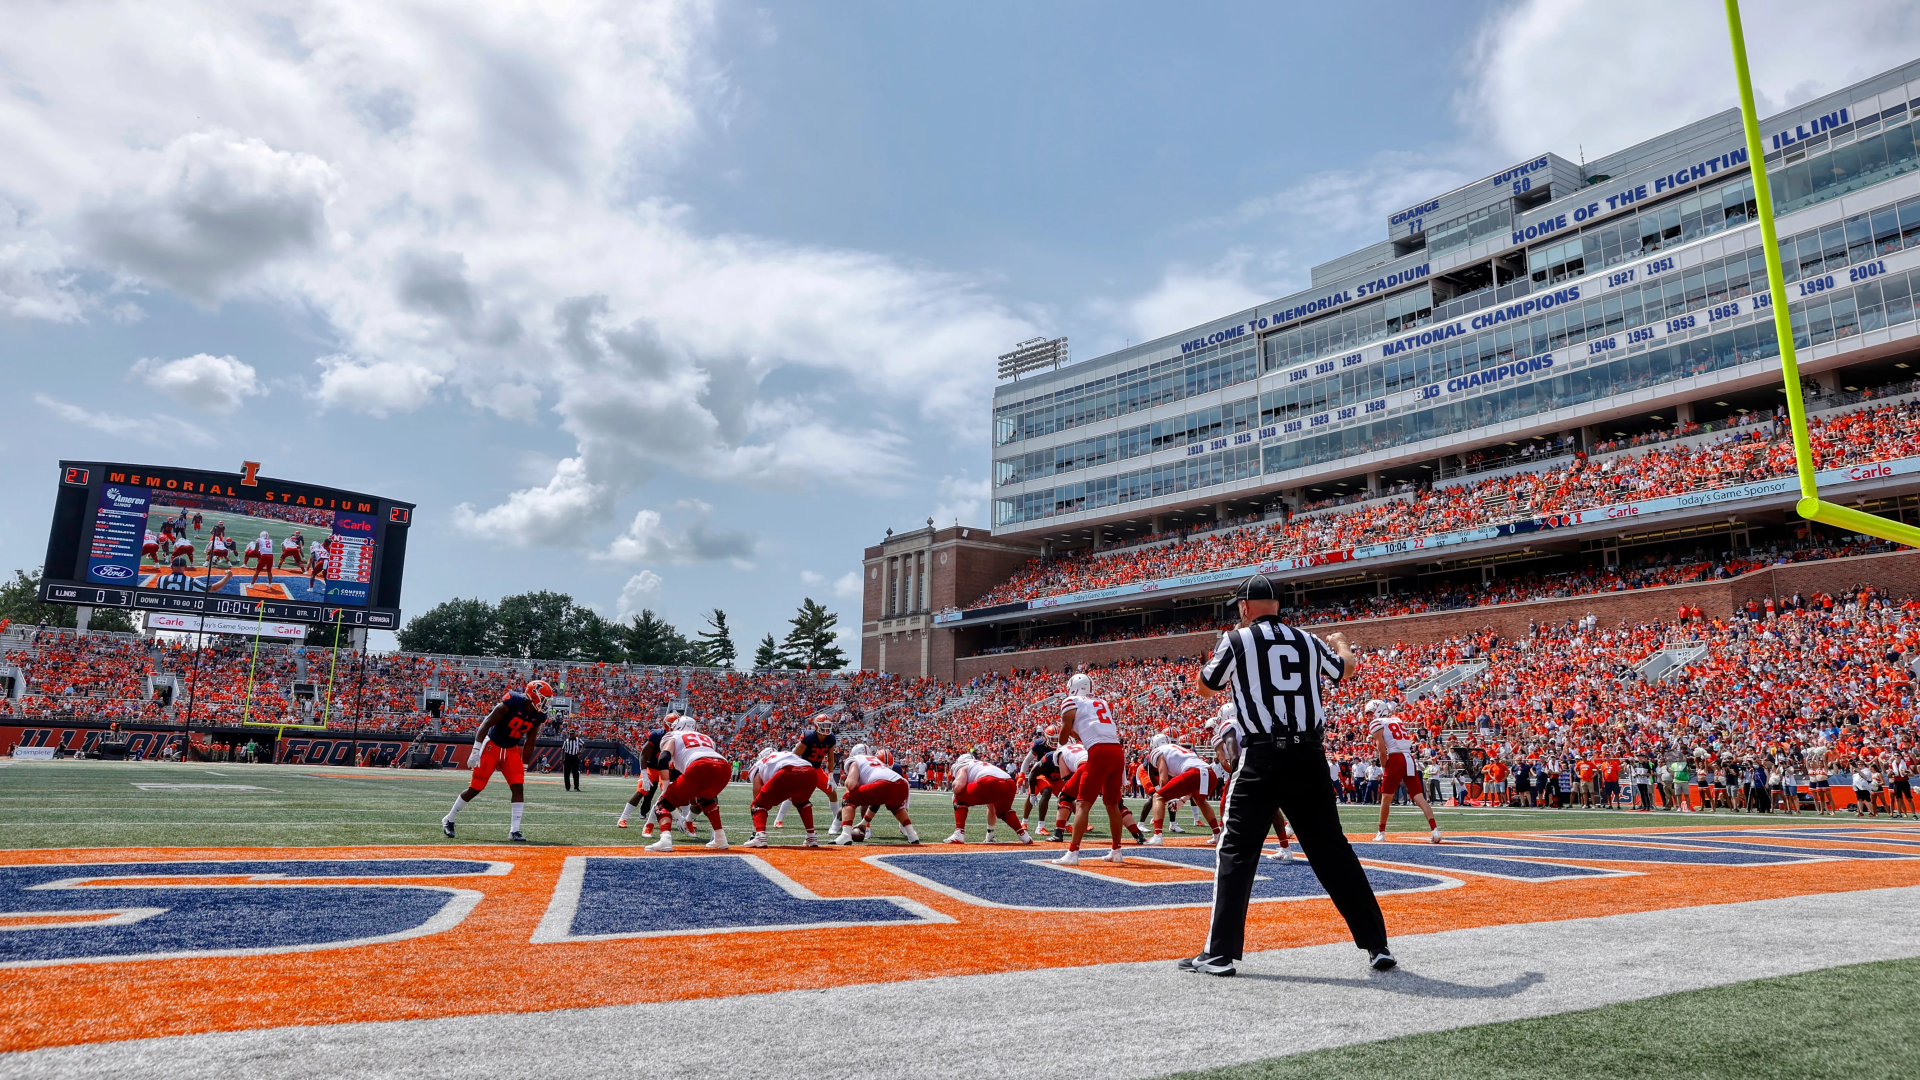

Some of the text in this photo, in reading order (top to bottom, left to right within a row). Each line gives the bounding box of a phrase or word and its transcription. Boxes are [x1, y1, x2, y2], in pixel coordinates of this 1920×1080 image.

[1493, 156, 1548, 186] BUTKUS
[1512, 108, 1849, 245] HOME OF THE FIGHTIN ILLINI
[1513, 177, 1531, 196] 50
[1390, 200, 1440, 225] GRANGE
[1408, 218, 1423, 234] 77
[1180, 262, 1431, 354] WELCOME TO MEMORIAL STADIUM
[1289, 257, 1675, 382] 1914 1919 1923 NATIONAL CHAMPIONS 1927 1951
[1210, 438, 1227, 450] 1914
[1234, 432, 1252, 445] 1915
[1258, 426, 1276, 440] 1918
[1284, 420, 1302, 434] 1919
[1310, 414, 1330, 428] 1923
[1337, 406, 1357, 420] 1927
[1364, 400, 1386, 414] 1928
[1447, 354, 1554, 394] CHAMPIONS
[1588, 338, 1616, 356] 1946
[1627, 326, 1655, 345] 1951
[1666, 315, 1696, 334] 1953
[1708, 302, 1740, 323] 1963
[1752, 293, 1772, 310] 198
[1799, 276, 1834, 296] 1990
[1849, 260, 1886, 282] 2001
[66, 469, 88, 484] 21
[241, 460, 261, 487] I
[110, 472, 372, 512] MEMORIAL STADIUM
[114, 494, 146, 505] Ameren
[1575, 464, 1892, 524] I Carle Today's Game Sponsor Carle
[391, 508, 408, 521] 21
[343, 519, 372, 531] Carle
[1509, 524, 1516, 534] 0
[1385, 538, 1424, 553] 10:04 22
[1343, 551, 1348, 560] 0
[100, 566, 126, 578] Ford
[1043, 599, 1058, 607] Carle
[1073, 593, 1087, 602] Today's
[1100, 589, 1118, 598] Sponsor
[1142, 583, 1158, 592] Carle
[1179, 576, 1196, 585] Today's
[1197, 575, 1211, 583] Game
[1212, 572, 1233, 582] Sponsor
[1260, 563, 1278, 574] Carle
[55, 589, 76, 598] ILLINOIS
[96, 590, 105, 602] 0
[120, 596, 127, 604] 3
[193, 600, 204, 609] 10
[216, 601, 250, 614] 10:04
[158, 616, 184, 626] Carle
[355, 612, 363, 623] 0
[278, 626, 301, 635] Carle
[1267, 644, 1302, 691] C
[1093, 701, 1112, 724] 2
[508, 716, 534, 739] 92
[682, 733, 714, 749] 69
[282, 738, 460, 768] FOOTBLL
[808, 748, 829, 762] 35
